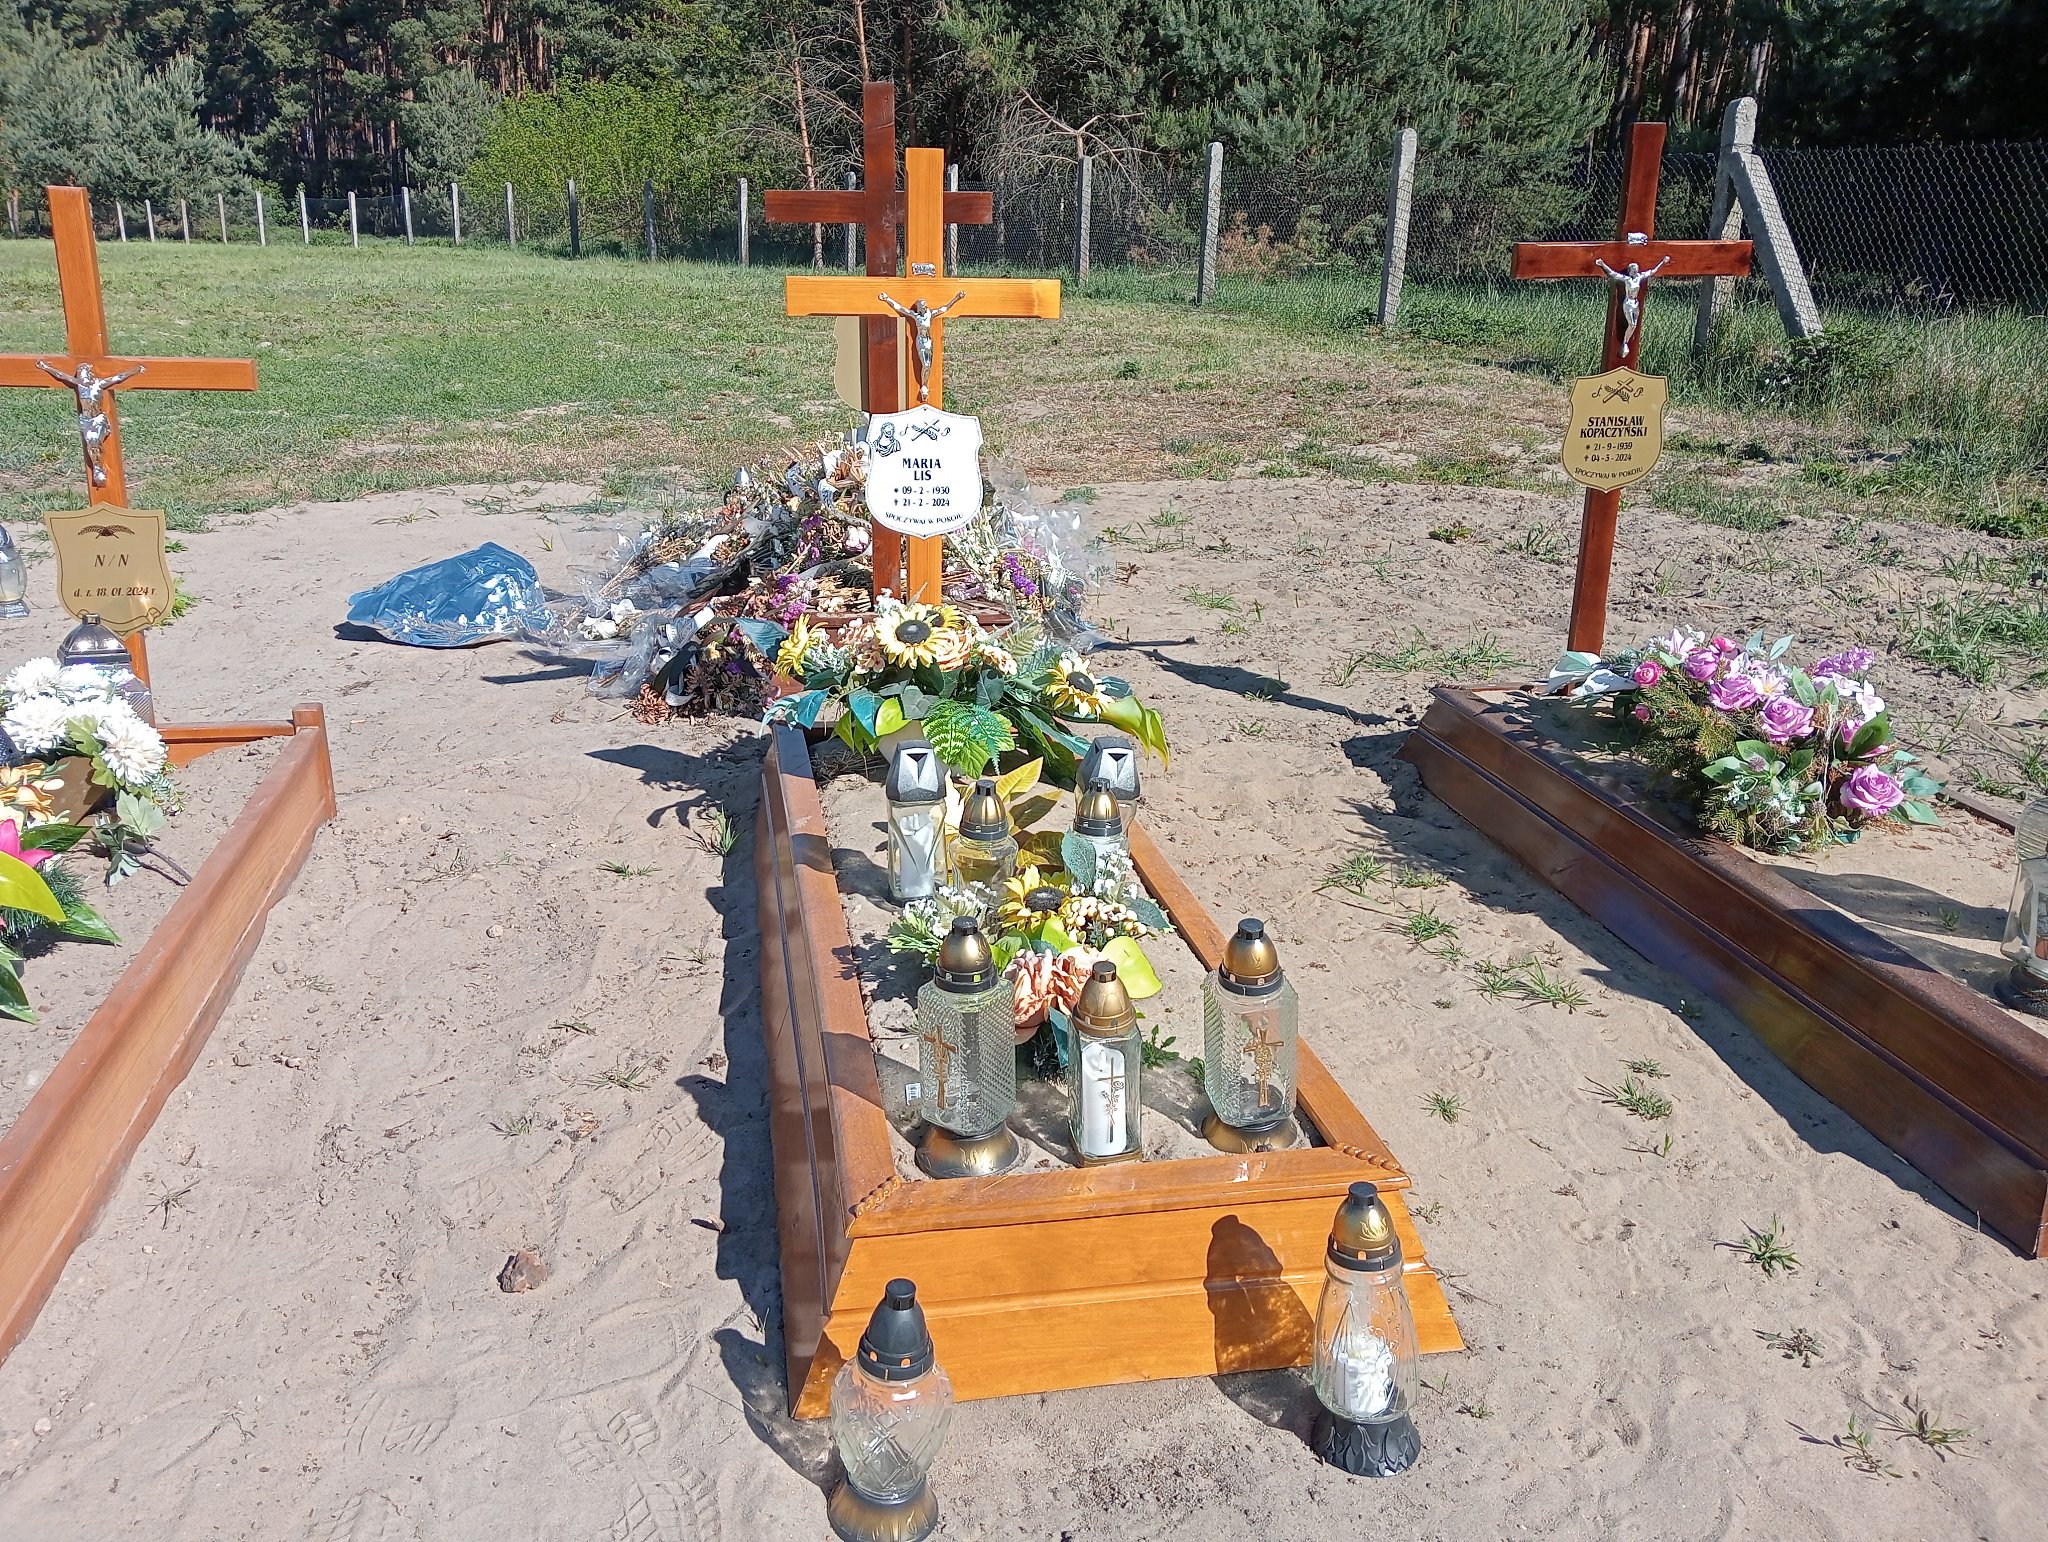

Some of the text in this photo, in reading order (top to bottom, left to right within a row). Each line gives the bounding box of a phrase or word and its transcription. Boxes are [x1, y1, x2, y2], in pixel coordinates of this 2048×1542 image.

[1587, 415, 1645, 427] STANISŁAW
[1580, 424, 1648, 438] KOPACZYŃSKI
[902, 458, 942, 469] MARIA
[914, 470, 932, 481] LIS
